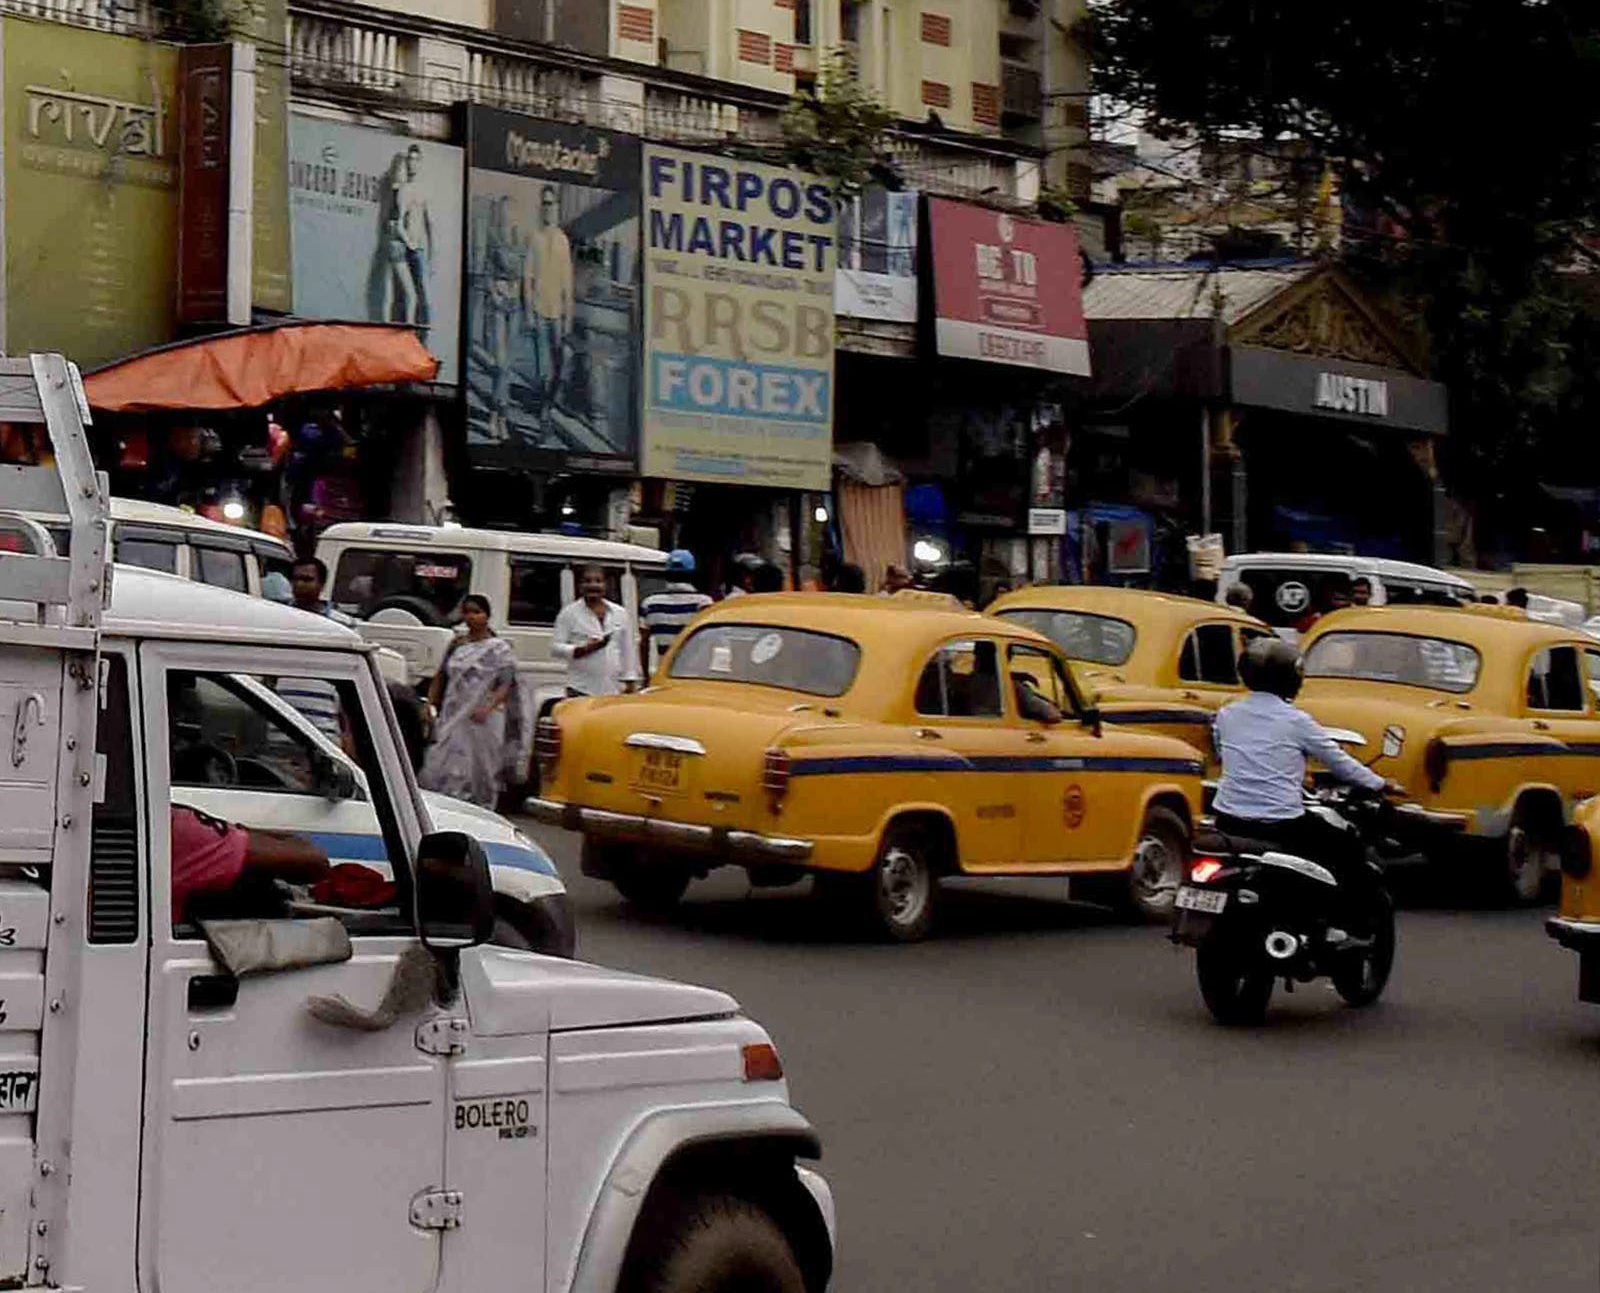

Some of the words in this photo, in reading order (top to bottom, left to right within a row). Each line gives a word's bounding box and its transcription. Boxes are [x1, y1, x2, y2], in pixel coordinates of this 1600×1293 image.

[24, 66, 168, 157] rival
[650, 209, 832, 272] MARKET
[653, 285, 832, 357] RRSB
[658, 358, 824, 416] FOREX
[1312, 372, 1389, 417] AUSTIN
[455, 1099, 530, 1130] BOLERO
